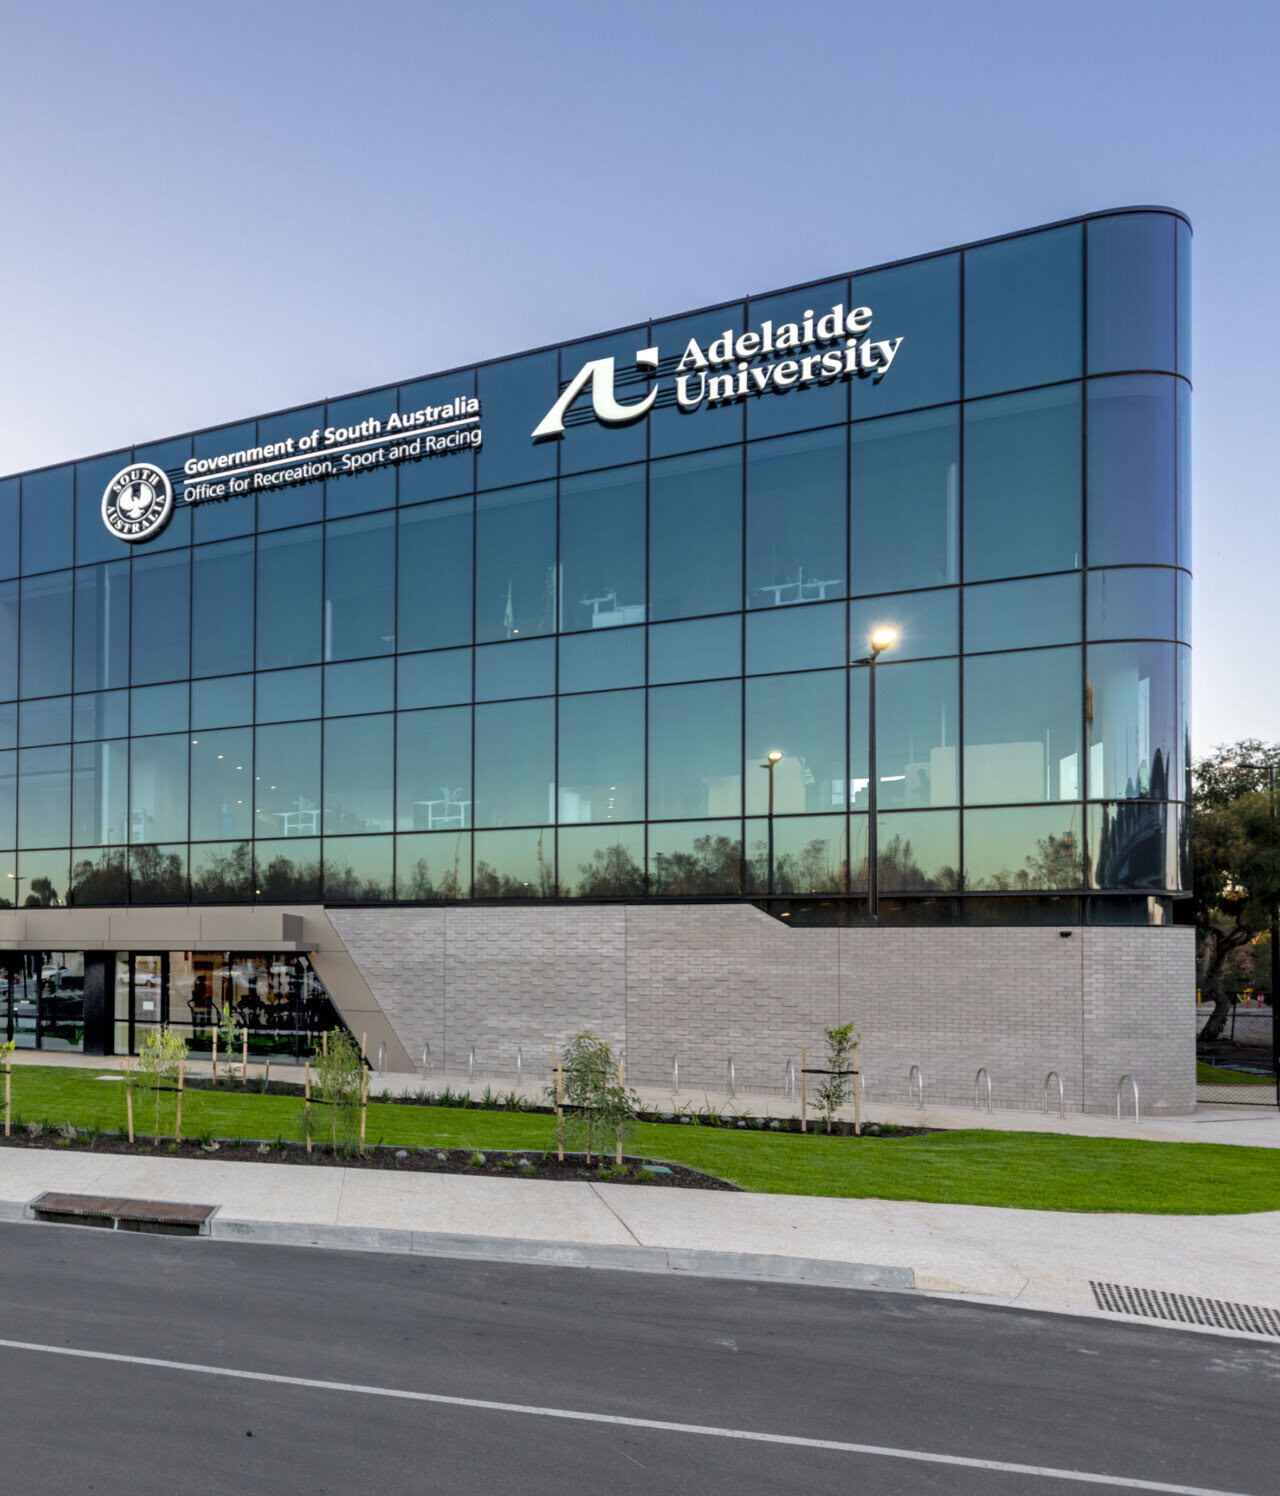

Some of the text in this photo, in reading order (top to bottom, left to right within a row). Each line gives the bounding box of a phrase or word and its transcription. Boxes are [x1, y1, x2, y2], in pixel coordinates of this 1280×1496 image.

[675, 303, 873, 372] Adelaide
[675, 336, 905, 407] University
[184, 396, 479, 475] Government of South Australia
[184, 428, 482, 502] Office for Recreation, Sport and Racing
[107, 495, 165, 533] AUSTRALIA
[113, 469, 160, 493] SOUTH
